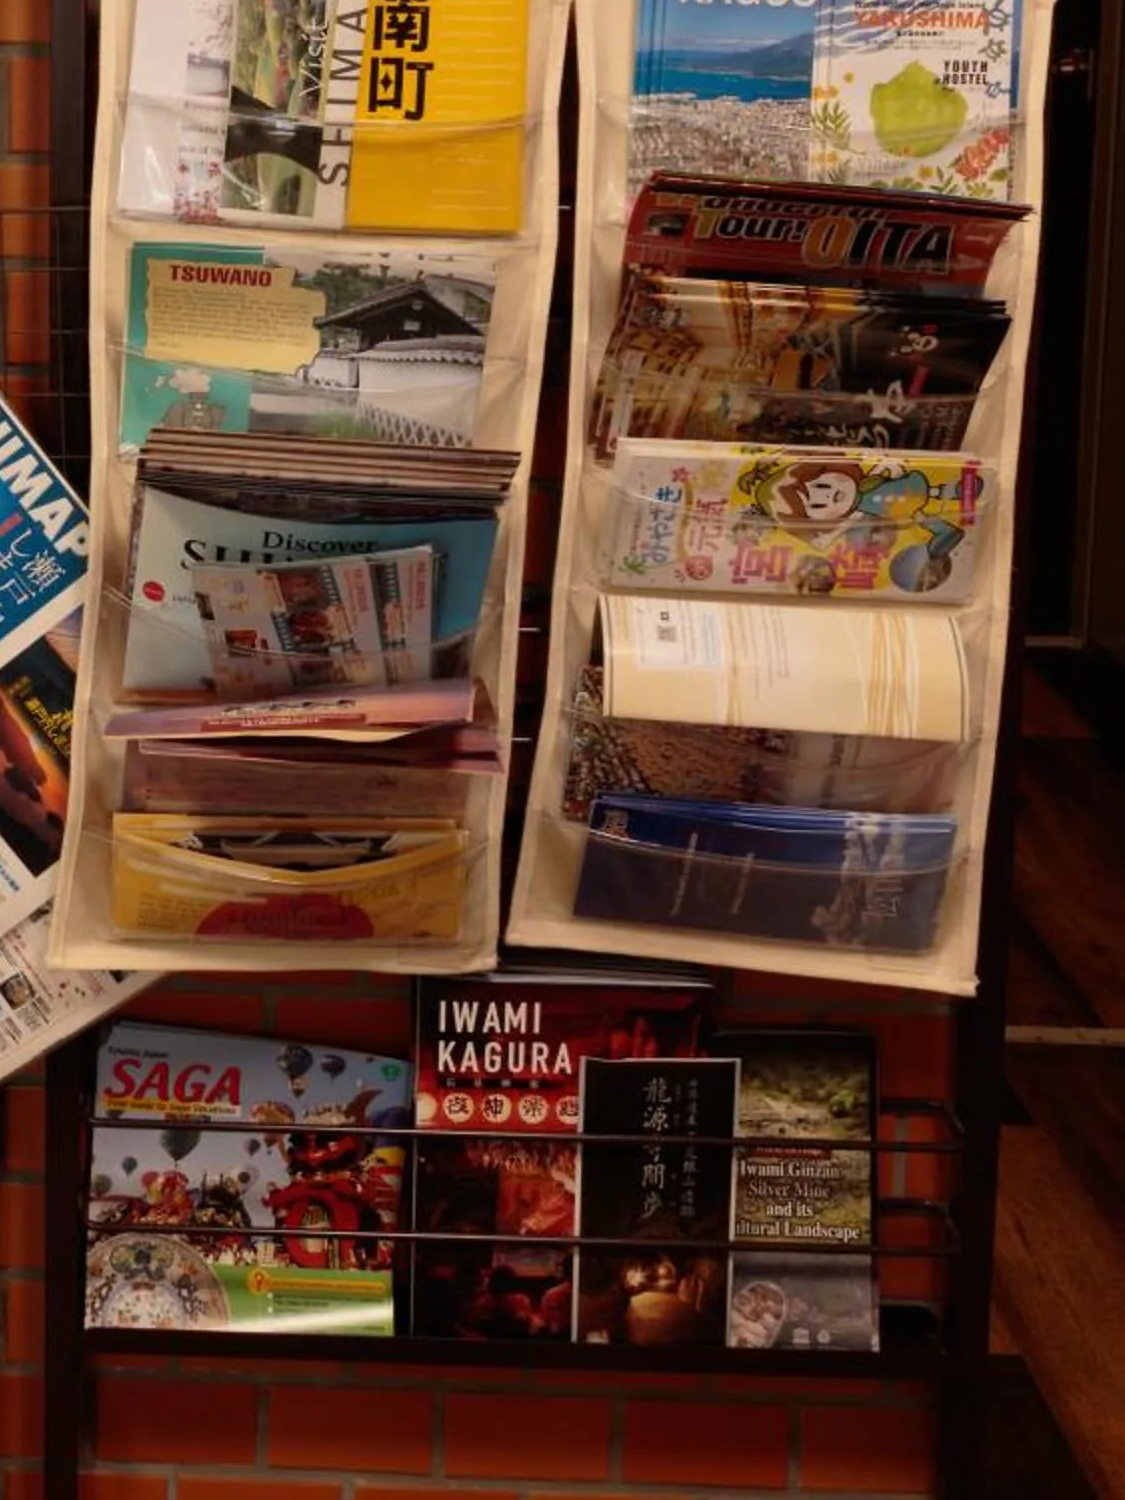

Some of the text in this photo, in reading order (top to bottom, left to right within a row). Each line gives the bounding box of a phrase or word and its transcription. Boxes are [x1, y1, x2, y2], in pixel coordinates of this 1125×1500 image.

[944, 60, 988, 73] YOUTH
[170, 265, 271, 288] TSUWANO
[263, 530, 379, 554] Discover
[439, 1000, 541, 1034] IWAMI
[437, 1040, 572, 1075] KAGURA
[103, 1057, 242, 1107] SAGA
[740, 1160, 785, 1178] Iwami
[748, 1182, 790, 1197] Silver
[766, 1202, 813, 1217] and its
[784, 1222, 860, 1243] Landscape
